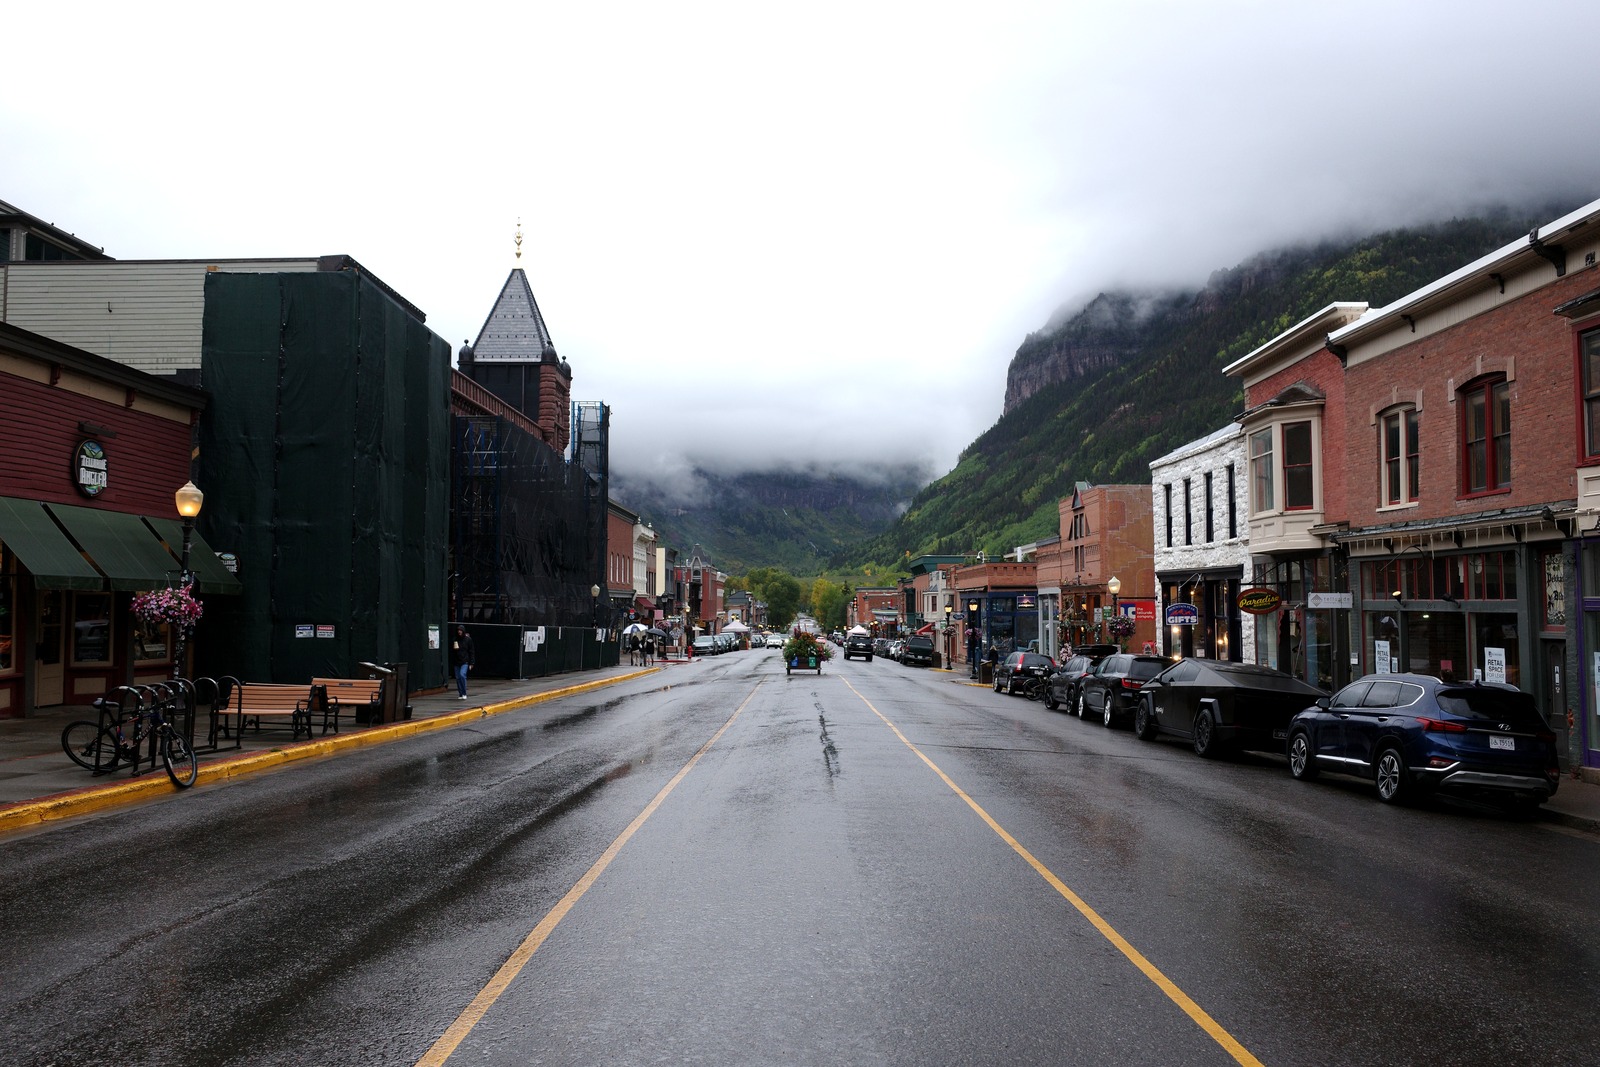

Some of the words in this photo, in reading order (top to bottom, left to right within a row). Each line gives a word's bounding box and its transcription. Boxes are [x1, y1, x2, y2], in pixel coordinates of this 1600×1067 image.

[79, 467, 107, 488] ANGLER
[1239, 594, 1280, 608] Paradise
[1167, 616, 1197, 624] GIFTS
[1487, 659, 1504, 667] RETAIL
